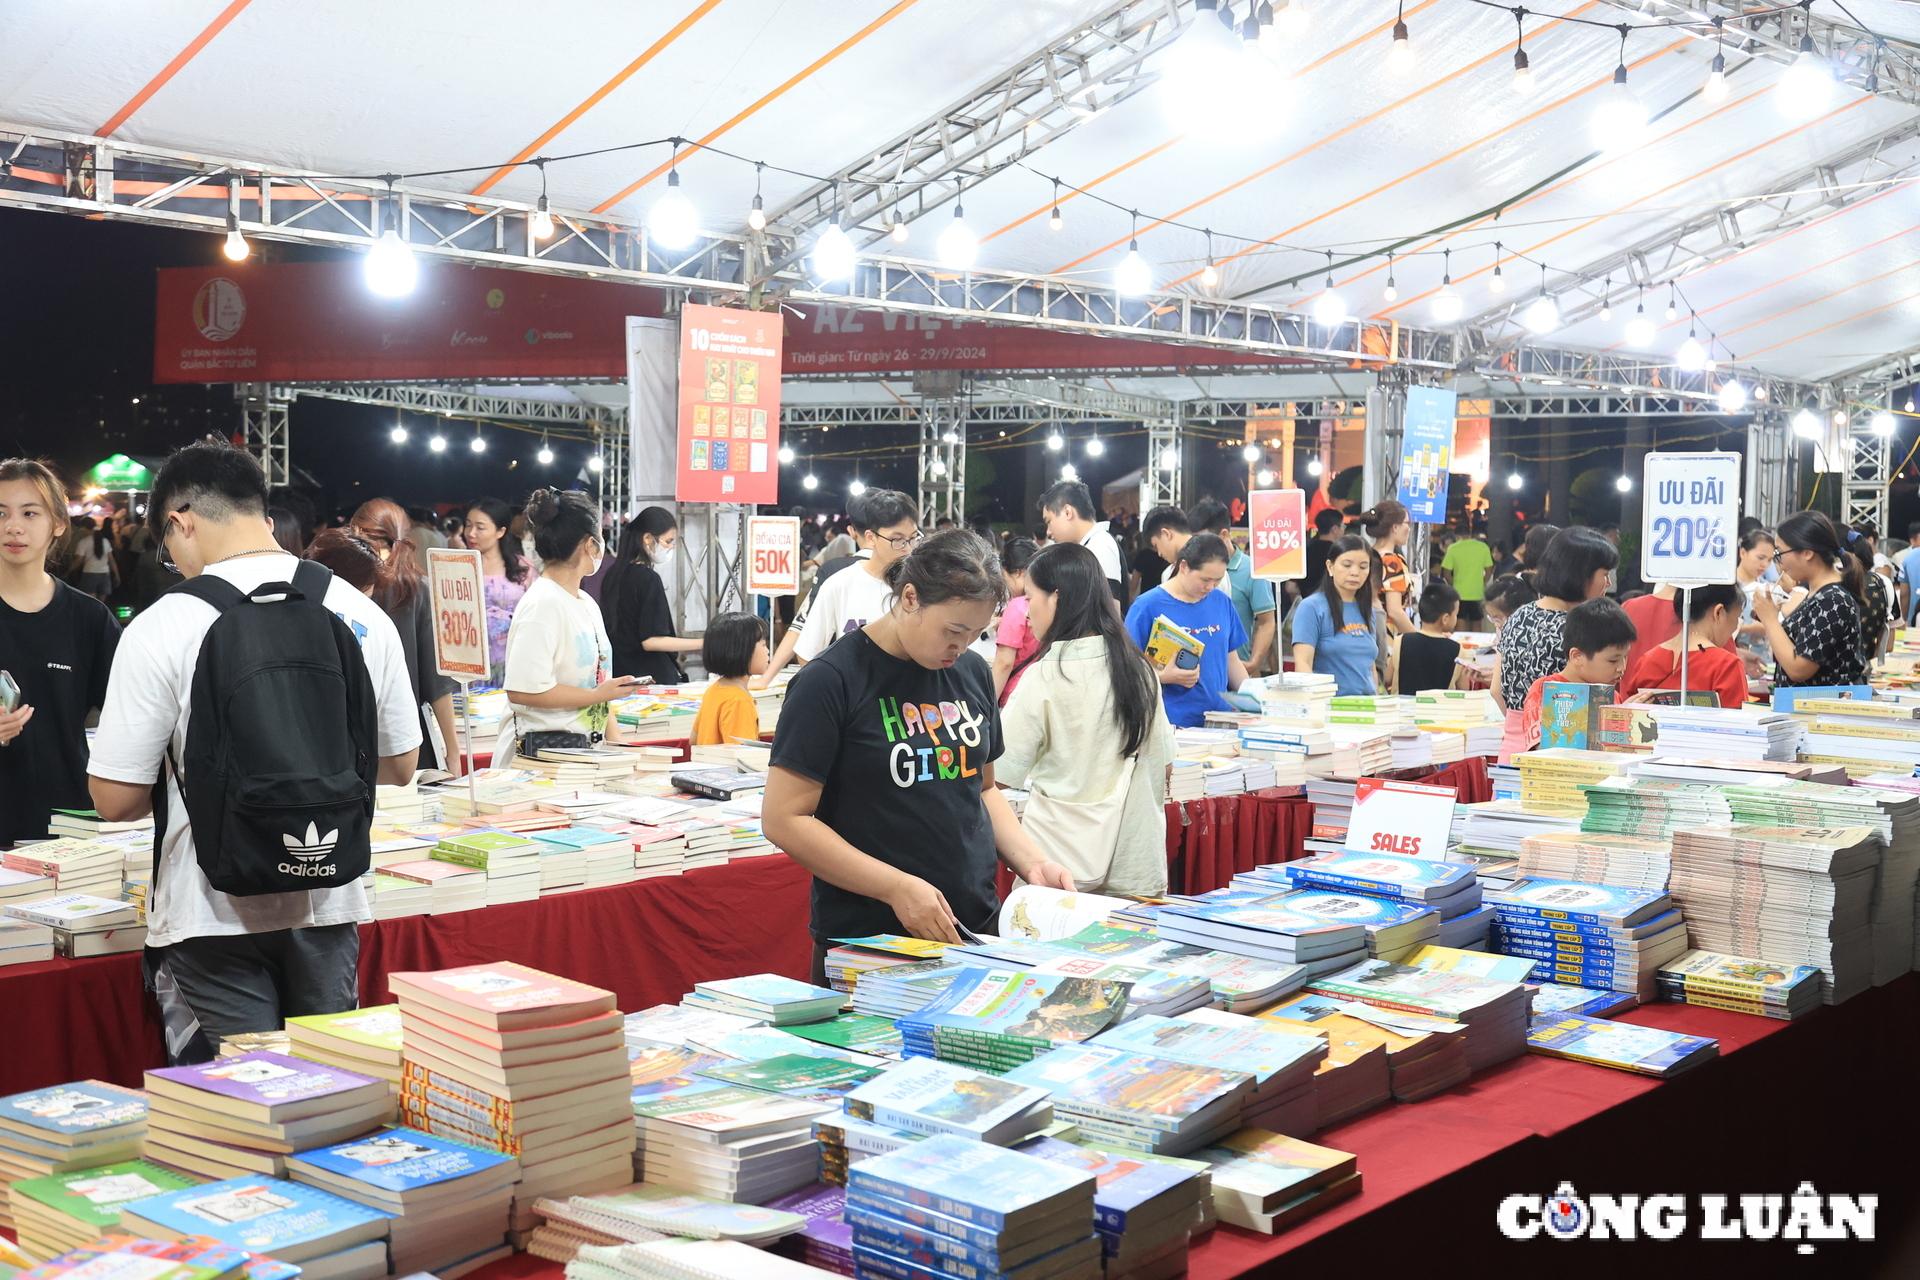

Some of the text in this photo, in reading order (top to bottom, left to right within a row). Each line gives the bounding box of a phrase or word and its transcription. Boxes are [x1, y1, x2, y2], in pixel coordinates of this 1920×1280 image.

[690, 328, 709, 351] 10
[791, 351, 816, 363] Thời
[818, 351, 845, 366] gian:
[864, 350, 891, 364] ngày
[894, 348, 909, 360] 26
[920, 347, 986, 361] 29/9/2024
[1690, 476, 1724, 505] ĐÃI
[1256, 530, 1300, 549] 30%
[1653, 517, 1726, 558] 20%
[755, 549, 791, 574] 50K
[442, 610, 477, 648] 30%
[879, 696, 984, 748] HAPPY
[889, 742, 978, 789] GIRL
[1371, 832, 1421, 855] SALES
[278, 863, 336, 876] adidas
